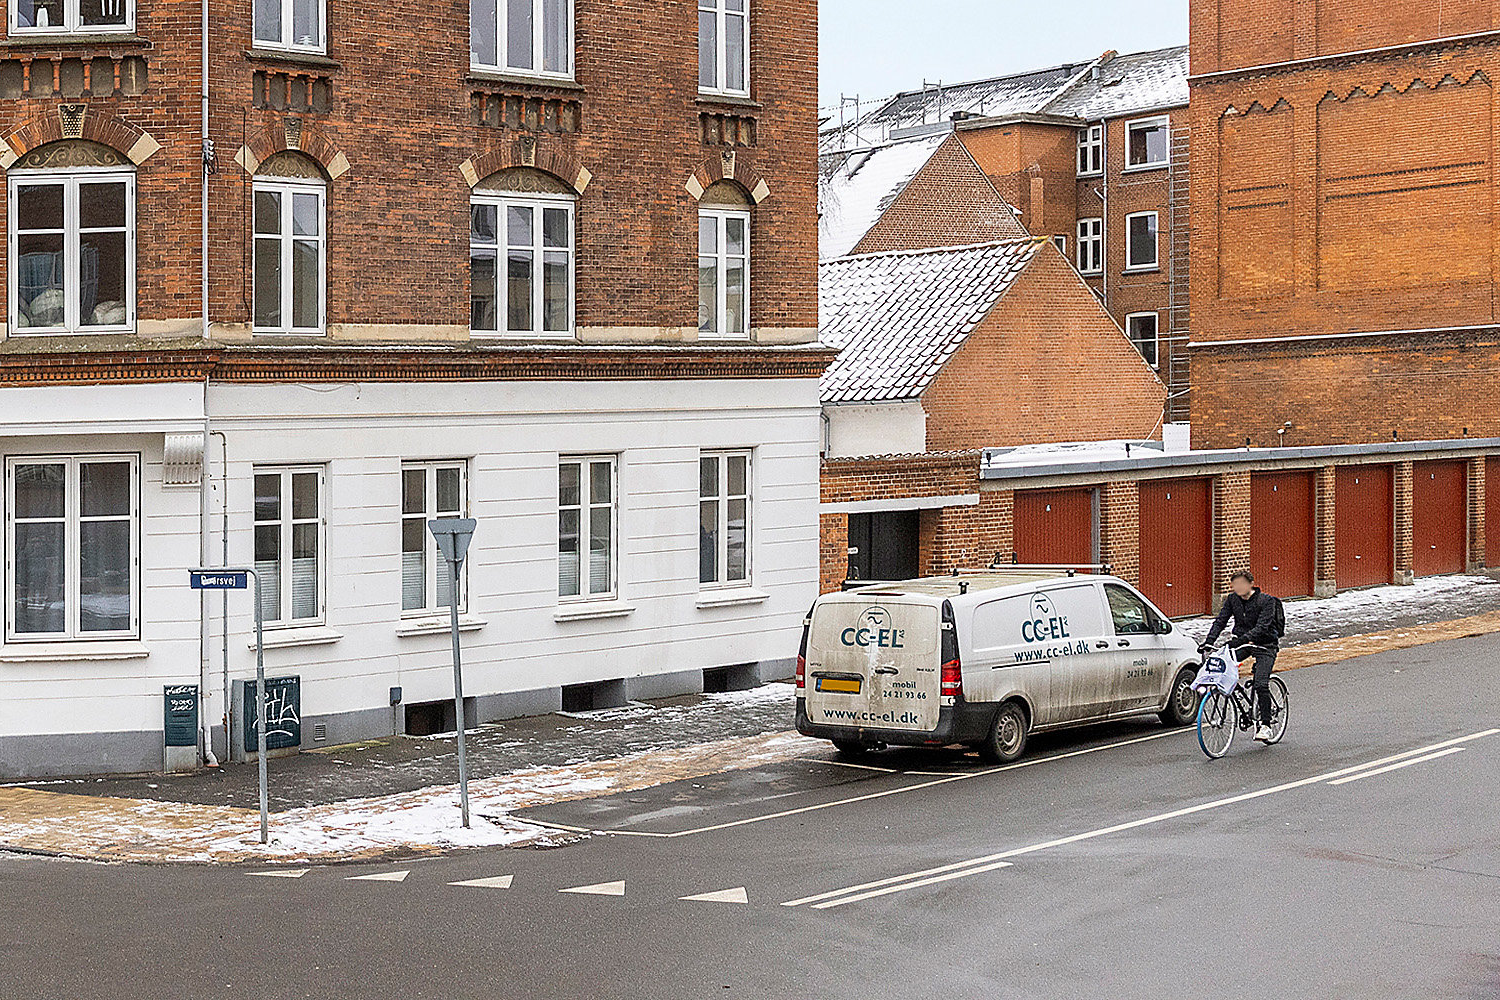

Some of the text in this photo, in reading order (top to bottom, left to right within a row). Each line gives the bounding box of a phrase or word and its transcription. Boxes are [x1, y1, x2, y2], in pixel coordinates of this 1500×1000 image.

[840, 627, 904, 648] CC-EL
[1021, 616, 1070, 643] CC-EL
[1014, 640, 1090, 662] www.cc-el.dk
[892, 681, 917, 689] mobil
[883, 690, 892, 698] 24
[905, 691, 915, 699] 93
[823, 709, 918, 724] www.cc-el.dk
